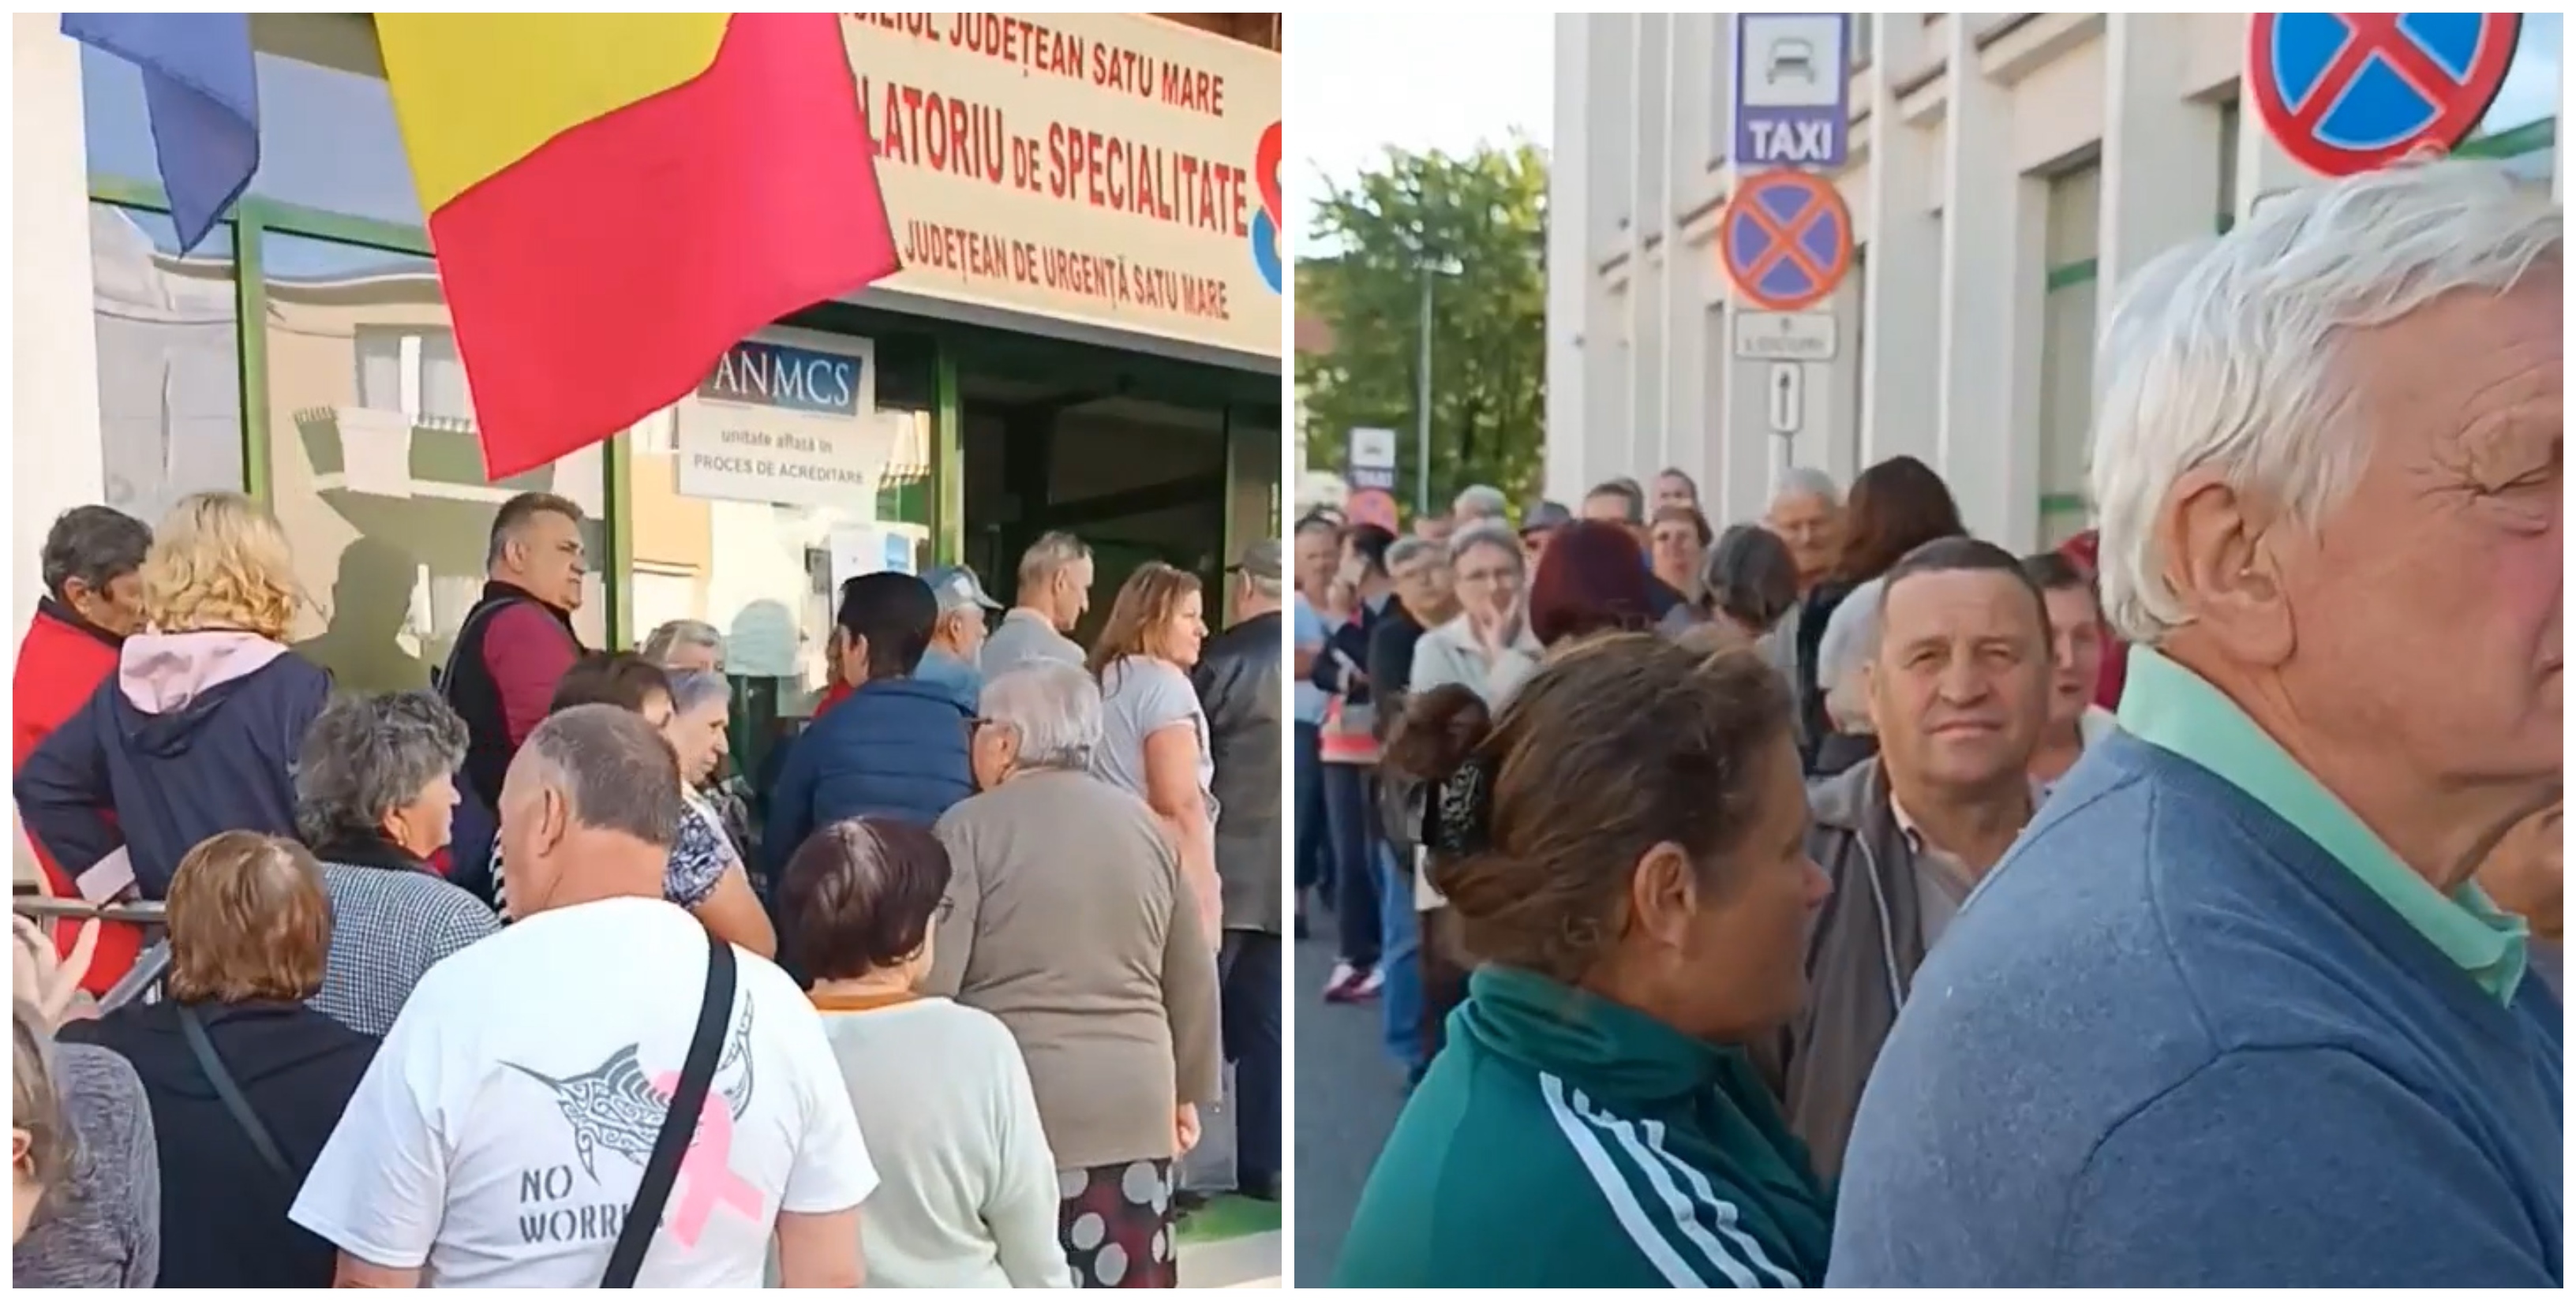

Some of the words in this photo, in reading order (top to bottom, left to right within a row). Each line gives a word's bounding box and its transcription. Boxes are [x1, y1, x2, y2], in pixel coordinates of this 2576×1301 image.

[1092, 43, 1153, 97] SATU
[1161, 62, 1224, 117] MARE
[863, 75, 1004, 184] LATORIU
[1013, 136, 1041, 193] DE
[1048, 122, 1249, 237] SPECIALITATE
[1748, 120, 1832, 160] TAXI
[1013, 240, 1039, 286] DE
[1133, 264, 1178, 310] SATU
[1181, 272, 1230, 320] MARE
[713, 350, 849, 407] ANMCS
[694, 454, 752, 474] PROCES
[756, 460, 775, 477] DE
[779, 462, 863, 484] ACREDITARE
[520, 1165, 573, 1204] NO
